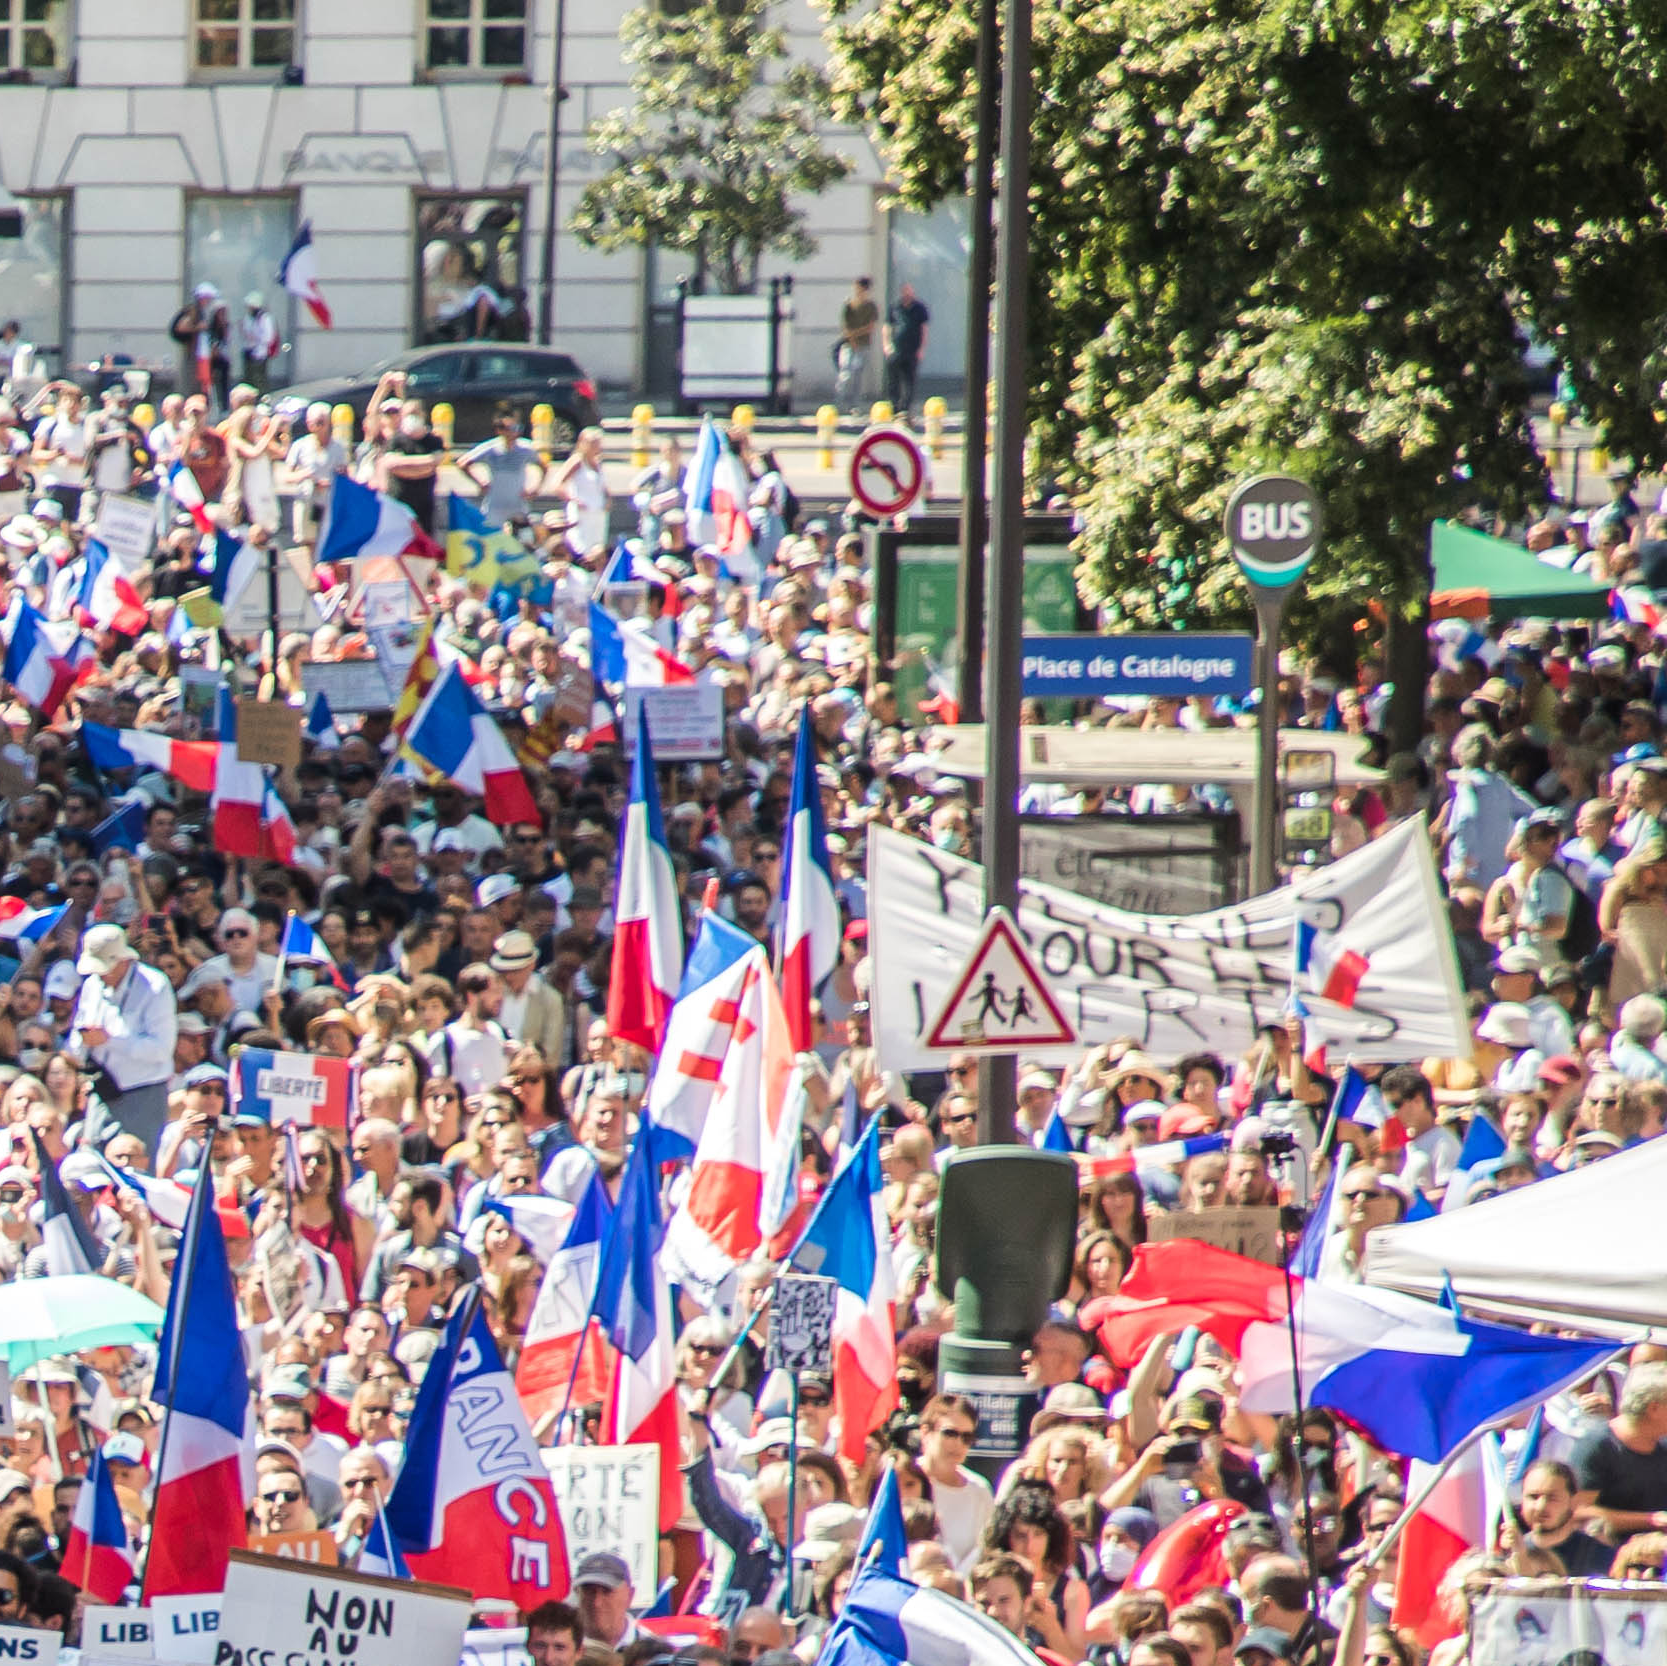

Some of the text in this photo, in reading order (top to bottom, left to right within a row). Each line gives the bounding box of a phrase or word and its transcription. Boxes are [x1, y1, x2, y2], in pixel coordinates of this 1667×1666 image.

[1241, 501, 1313, 541] BUS
[1021, 654, 1236, 684] Place de Catalogne
[305, 1588, 396, 1638] NON
[308, 1626, 359, 1656] AU
